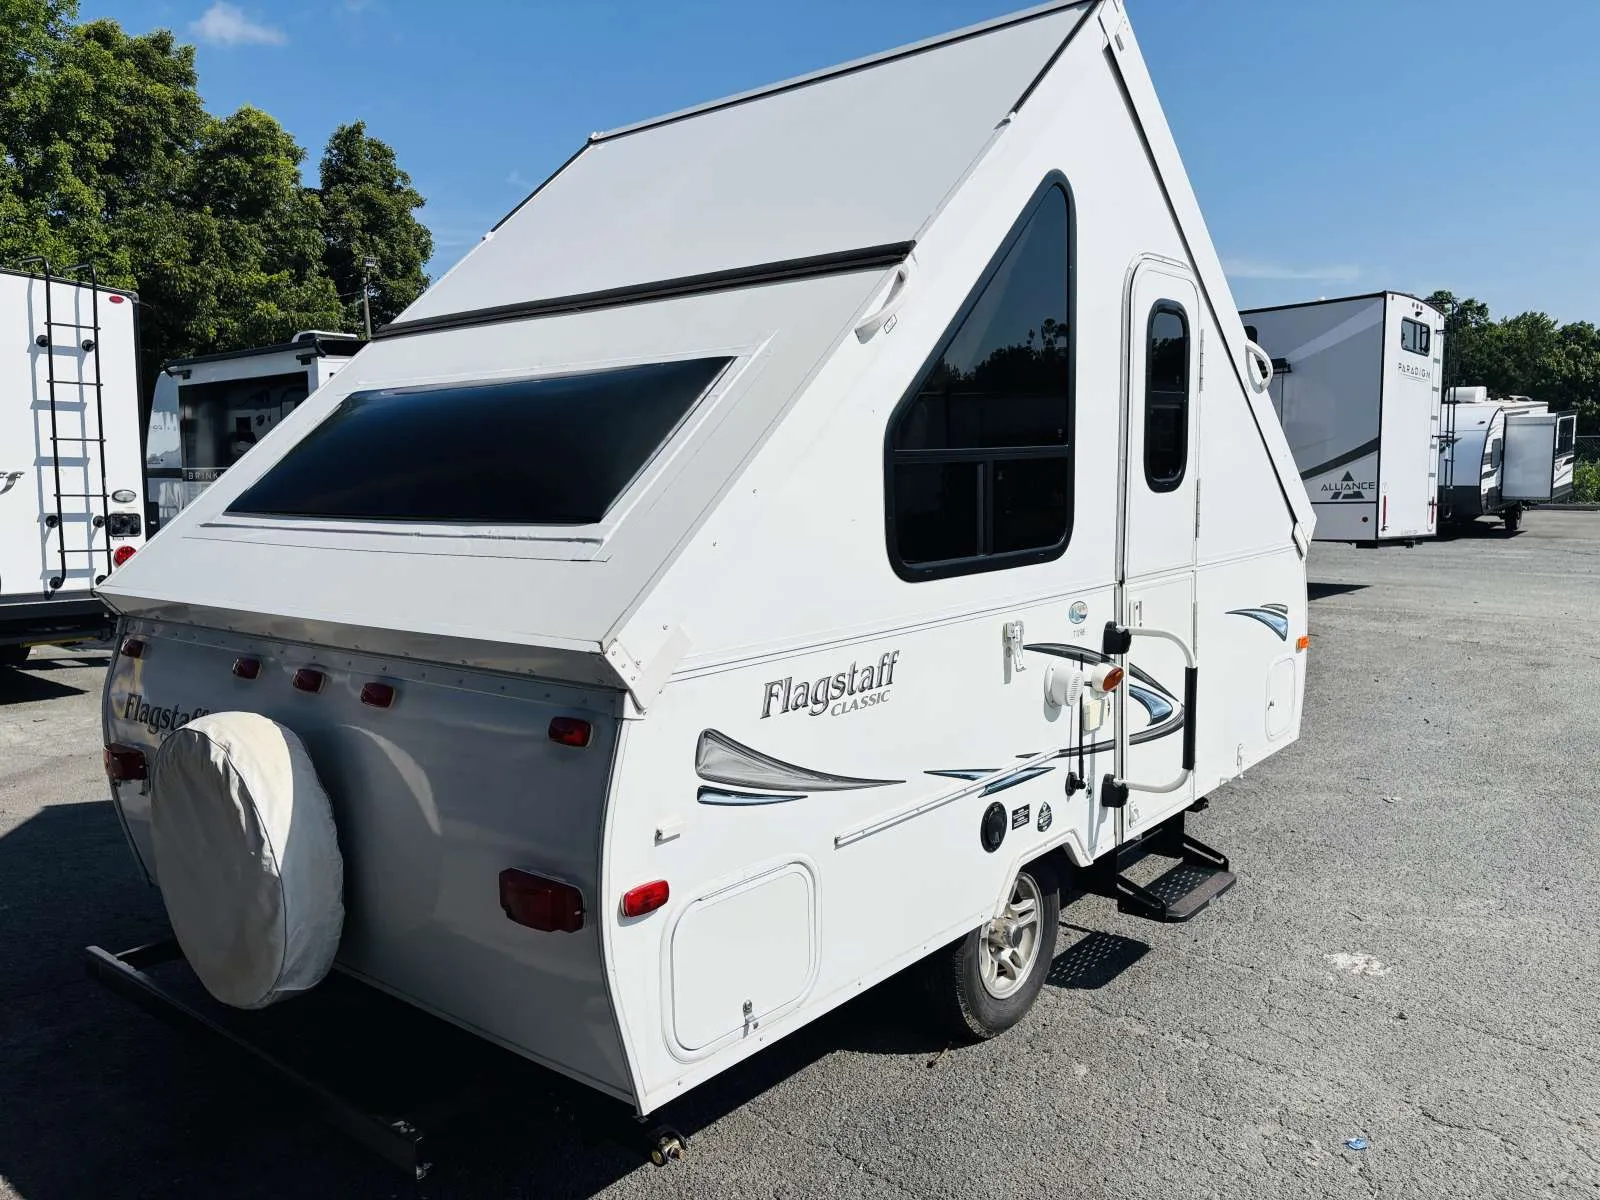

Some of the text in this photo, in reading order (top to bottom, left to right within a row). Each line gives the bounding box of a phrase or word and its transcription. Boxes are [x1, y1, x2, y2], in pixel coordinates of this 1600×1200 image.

[1398, 362, 1431, 378] PARADIGM
[188, 471, 222, 480] BRINK
[1320, 481, 1375, 492] ALLIANCE
[760, 650, 900, 719] Flagstaff
[830, 690, 891, 717] CLASSIC
